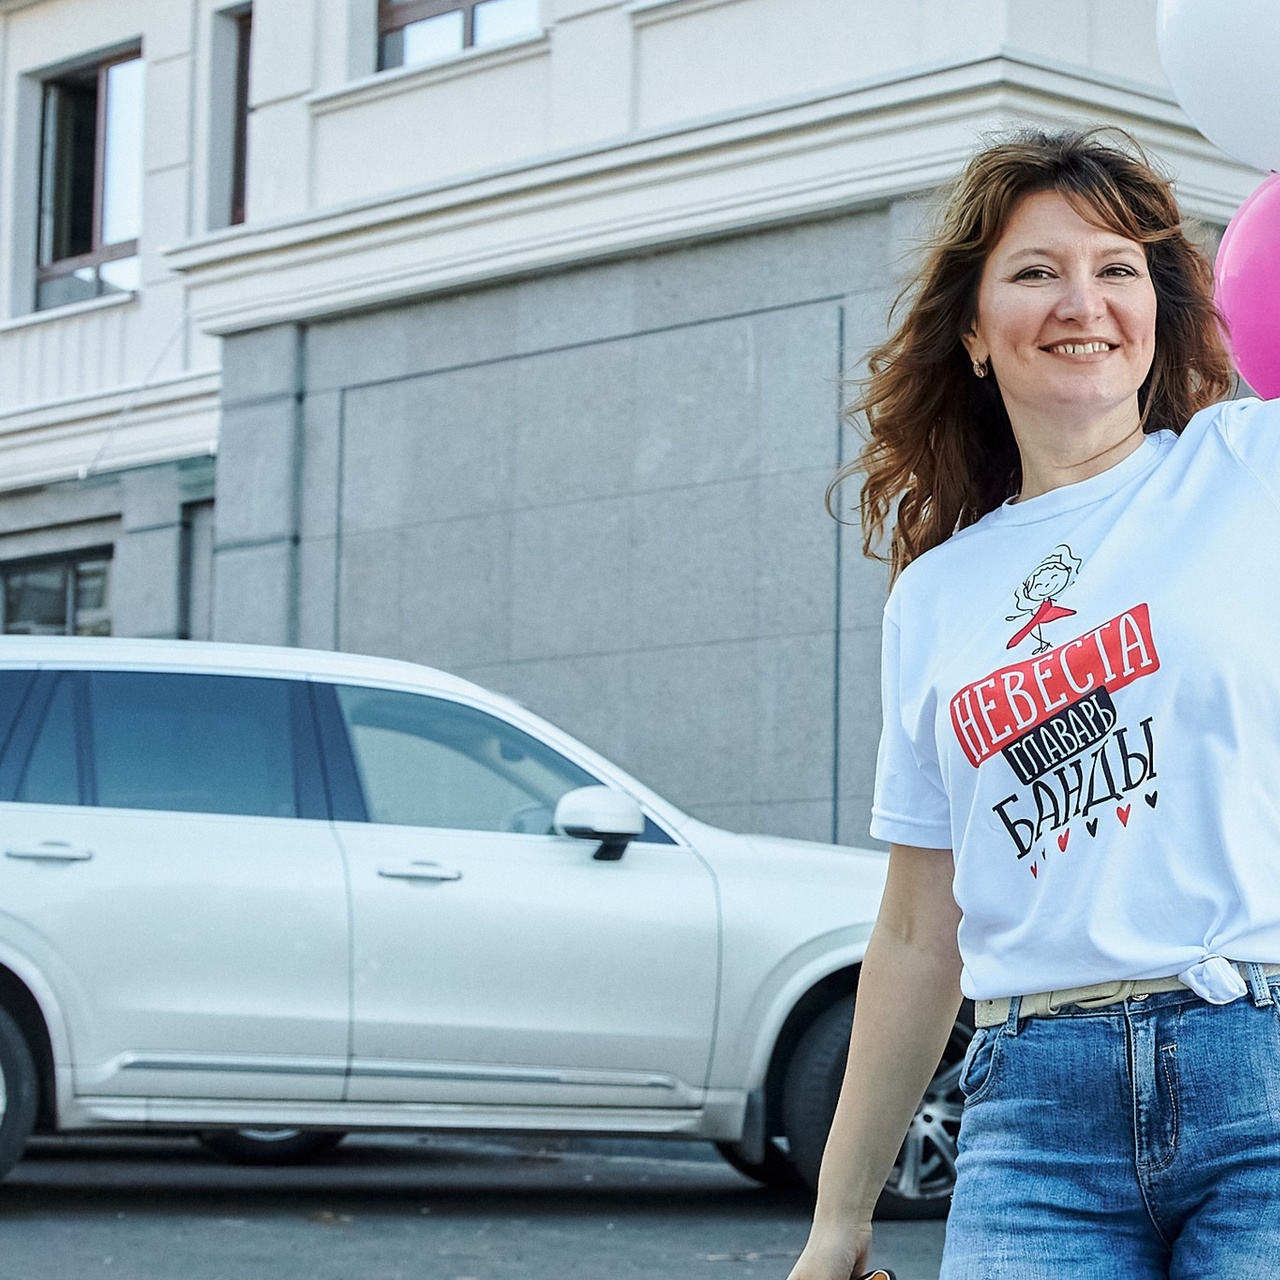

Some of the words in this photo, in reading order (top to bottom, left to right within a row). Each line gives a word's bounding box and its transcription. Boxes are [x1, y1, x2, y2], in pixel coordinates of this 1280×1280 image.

[953, 613, 1153, 762] НЕВЕСТА
[1007, 694, 1115, 781] ГЛАВАРЬ
[993, 717, 1157, 859] БАНДЫ
